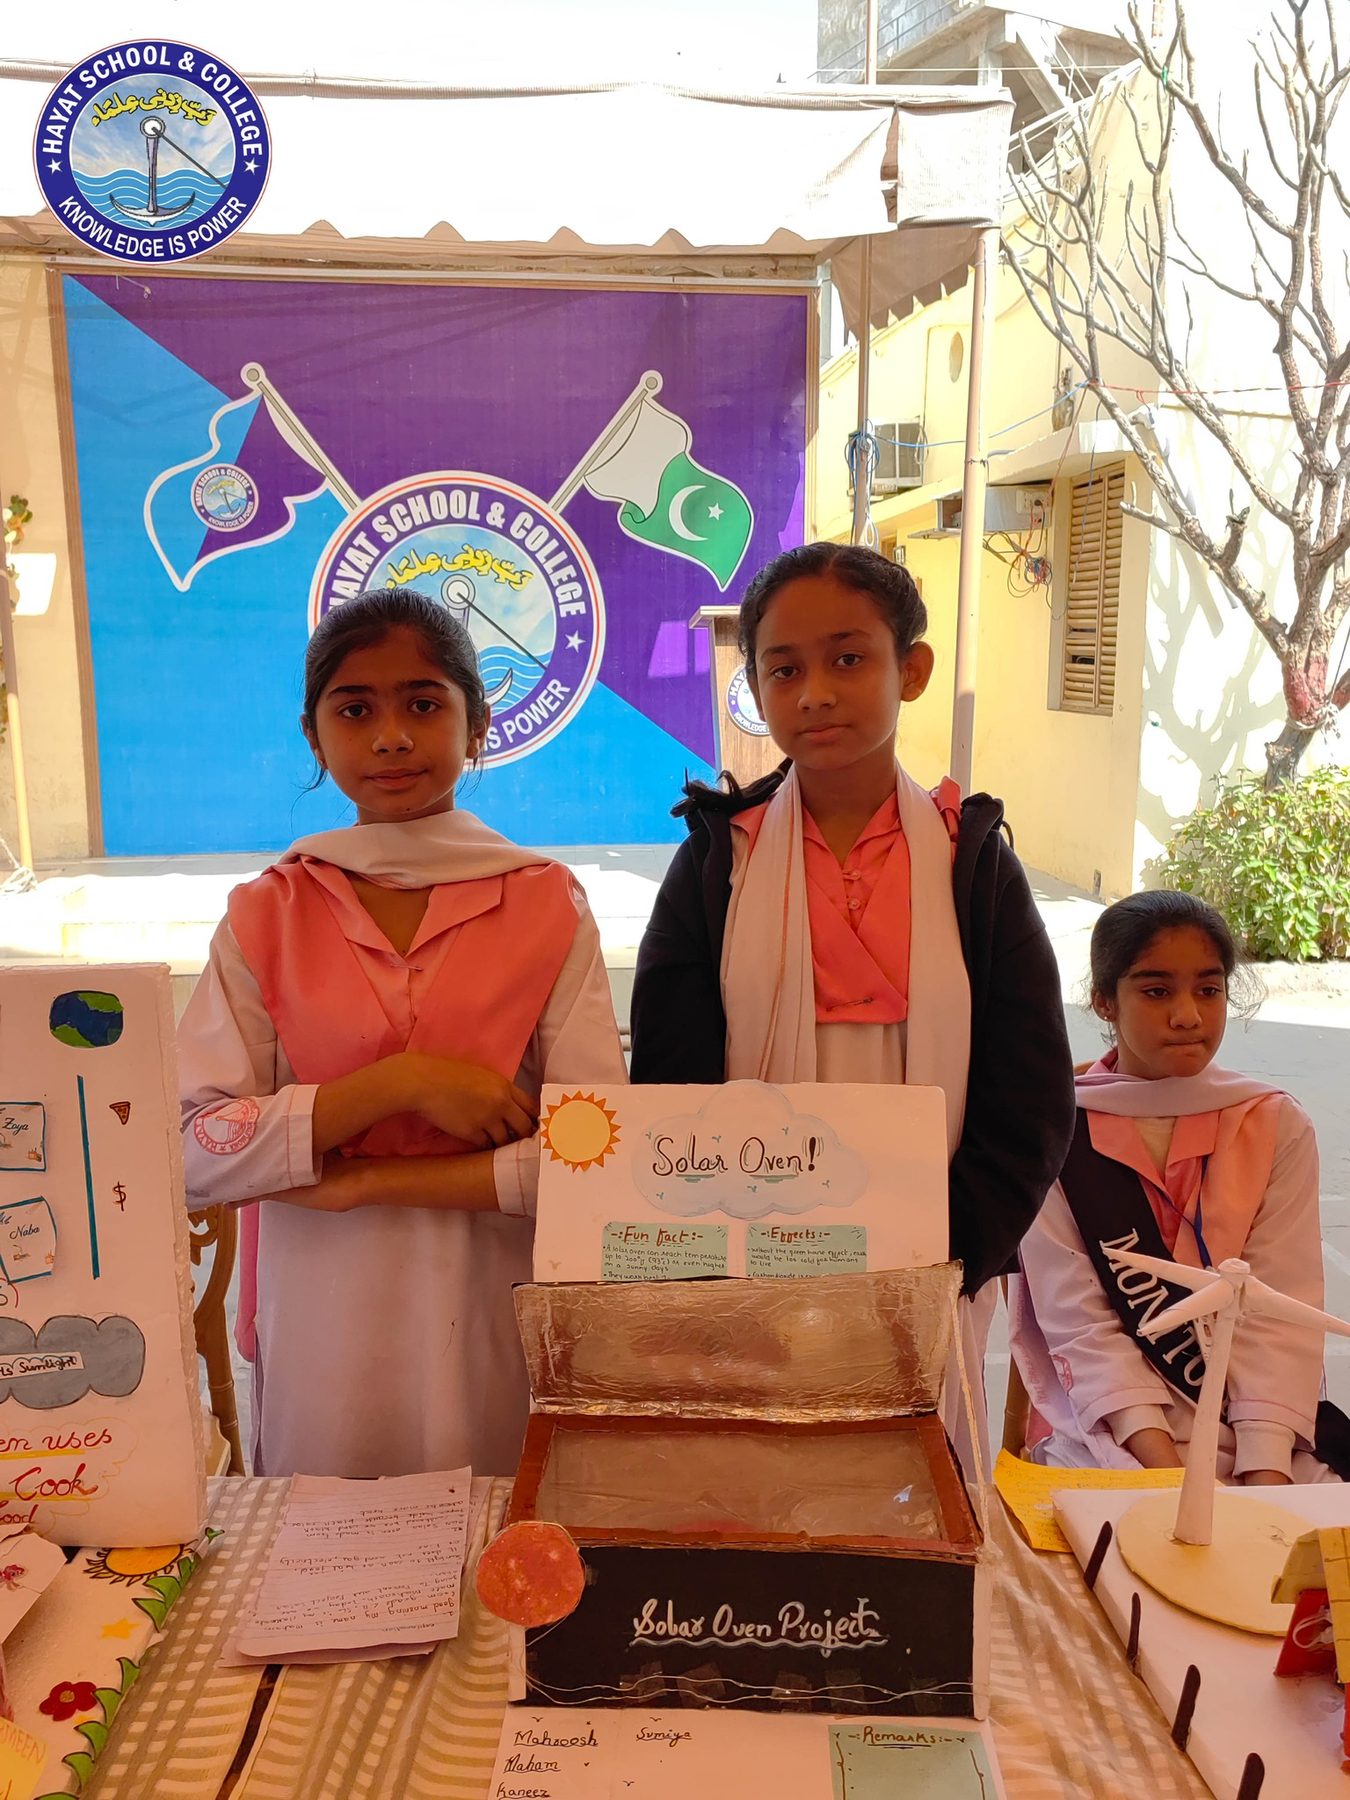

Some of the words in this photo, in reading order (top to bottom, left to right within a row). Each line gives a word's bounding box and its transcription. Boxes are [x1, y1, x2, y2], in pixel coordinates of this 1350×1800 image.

[371, 489, 481, 543] SCHOOL
[486, 501, 506, 528] &
[509, 510, 587, 618] COLLEGE
[729, 672, 747, 697] HAY
[506, 678, 571, 744] POWER
[1, 1117, 30, 1137] Zoya
[652, 1134, 729, 1177] Solar
[739, 1136, 817, 1174] Oven!
[19, 1356, 77, 1373] Sunlight
[42, 1428, 113, 1449] uses
[9, 1463, 99, 1502] Cook
[712, 1603, 772, 1637] Oven
[778, 1597, 881, 1658] Project
[504, 1753, 558, 1772] Maham
